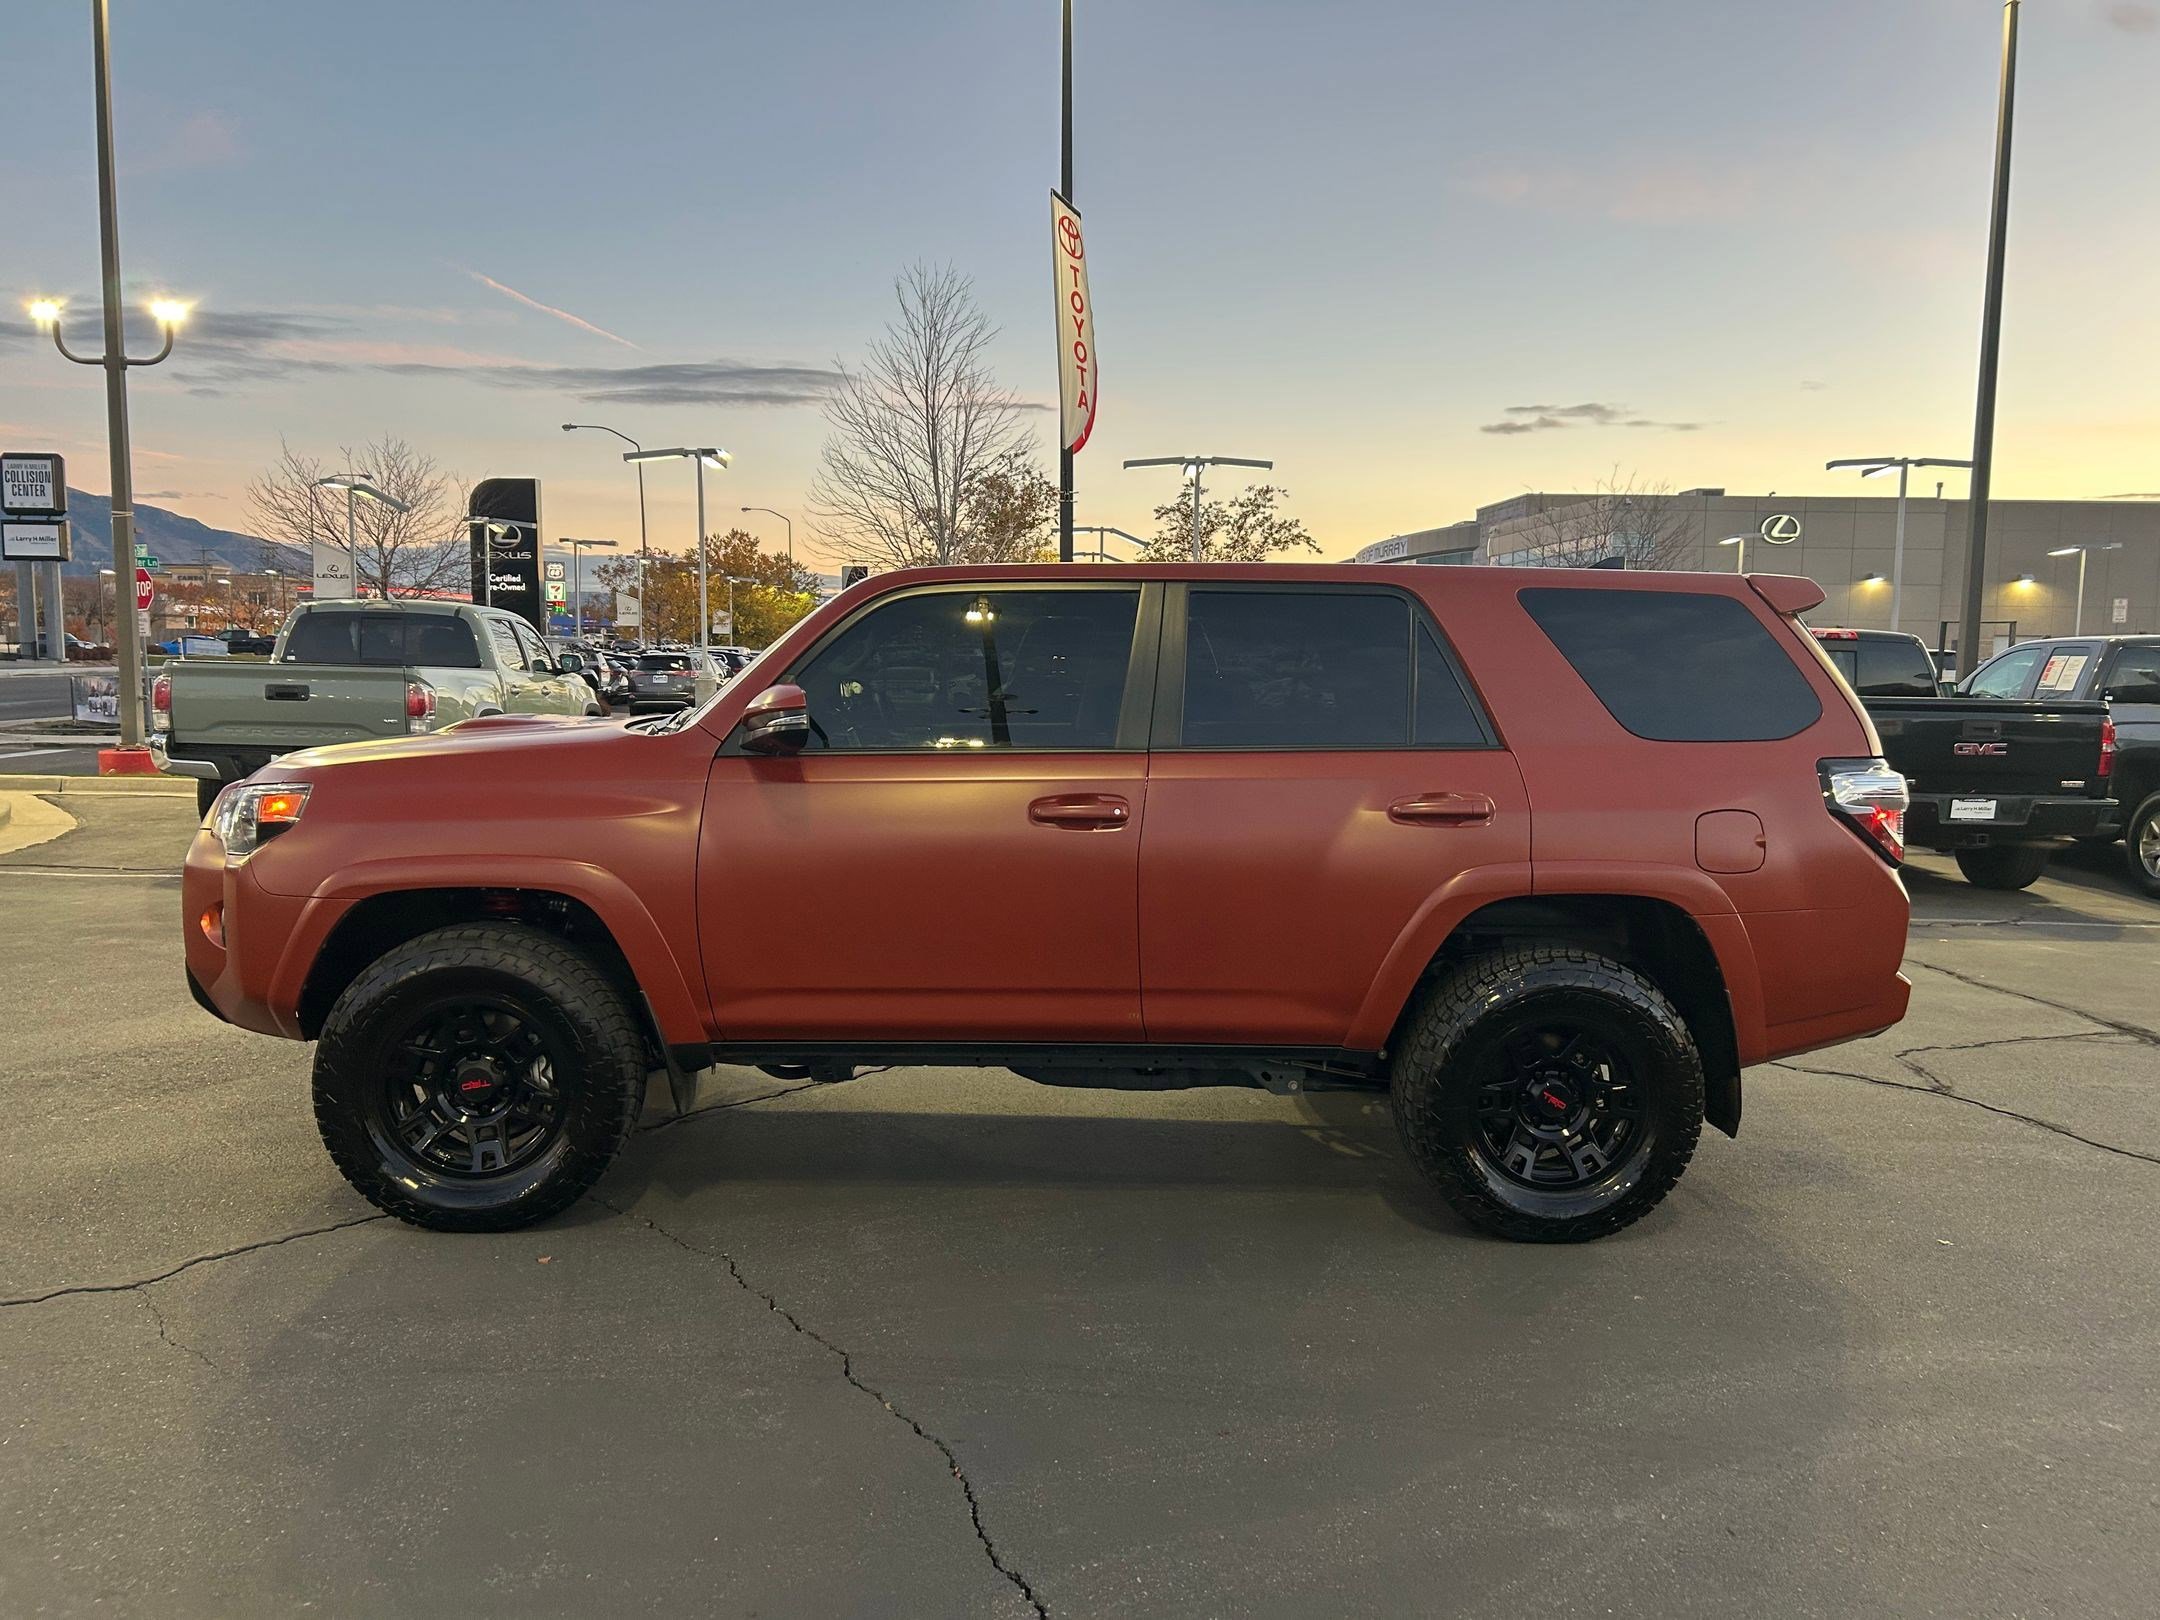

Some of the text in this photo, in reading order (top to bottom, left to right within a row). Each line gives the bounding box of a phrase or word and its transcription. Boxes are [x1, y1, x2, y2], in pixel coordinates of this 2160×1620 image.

[1070, 264, 1089, 413] TOYOTA
[4, 470, 51, 483] COLLISION
[11, 483, 46, 497] CENTER
[478, 551, 533, 559] LEXUS
[1374, 541, 1407, 558] MURRAY
[489, 574, 522, 582] Certified
[136, 581, 152, 597] TOP
[489, 583, 526, 591] re-Owned
[1953, 742, 2008, 756] GMC
